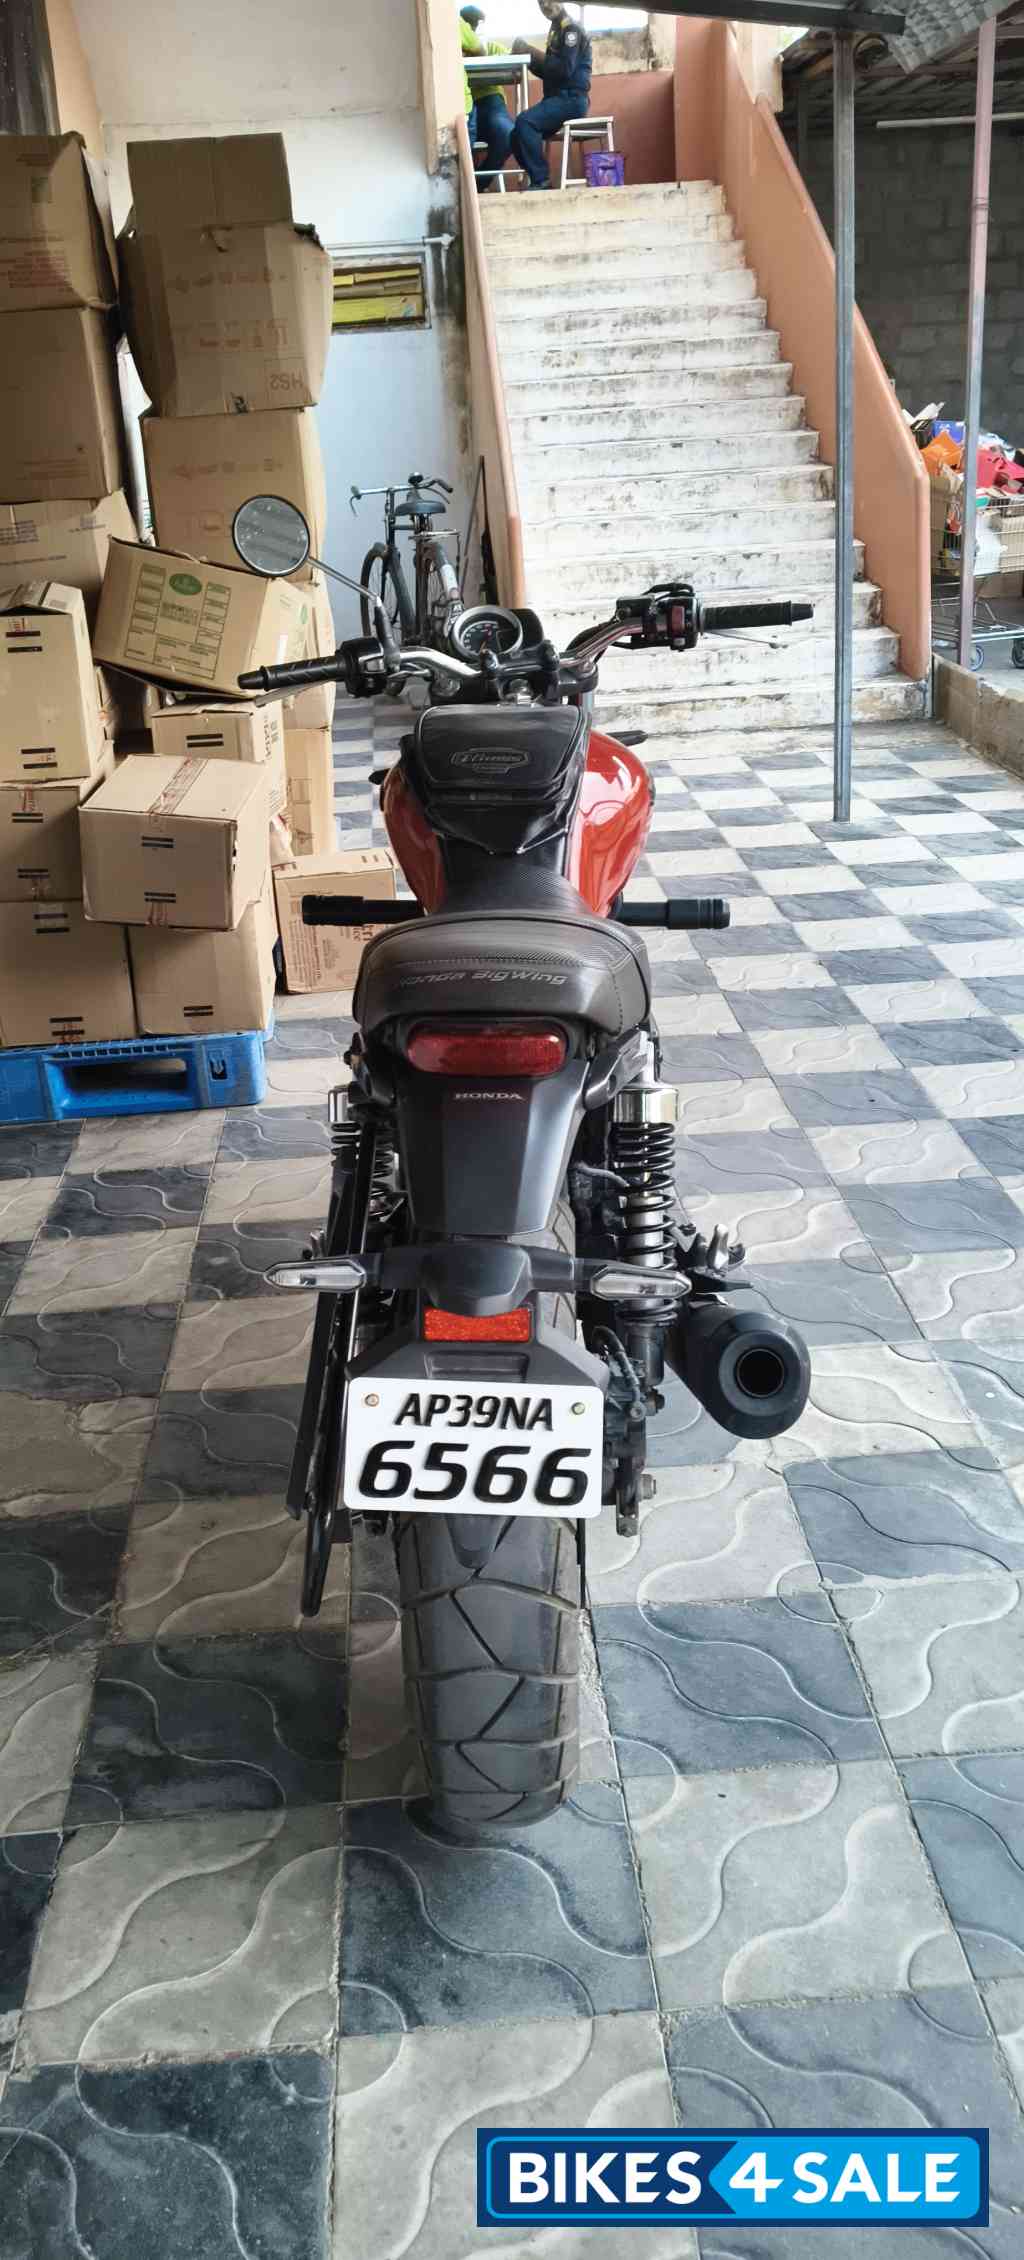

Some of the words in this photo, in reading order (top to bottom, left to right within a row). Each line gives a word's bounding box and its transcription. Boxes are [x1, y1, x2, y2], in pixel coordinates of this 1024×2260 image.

[455, 1092, 525, 1101] HONDA
[394, 1393, 553, 1431] AP39NA
[358, 1440, 592, 1506] 6566
